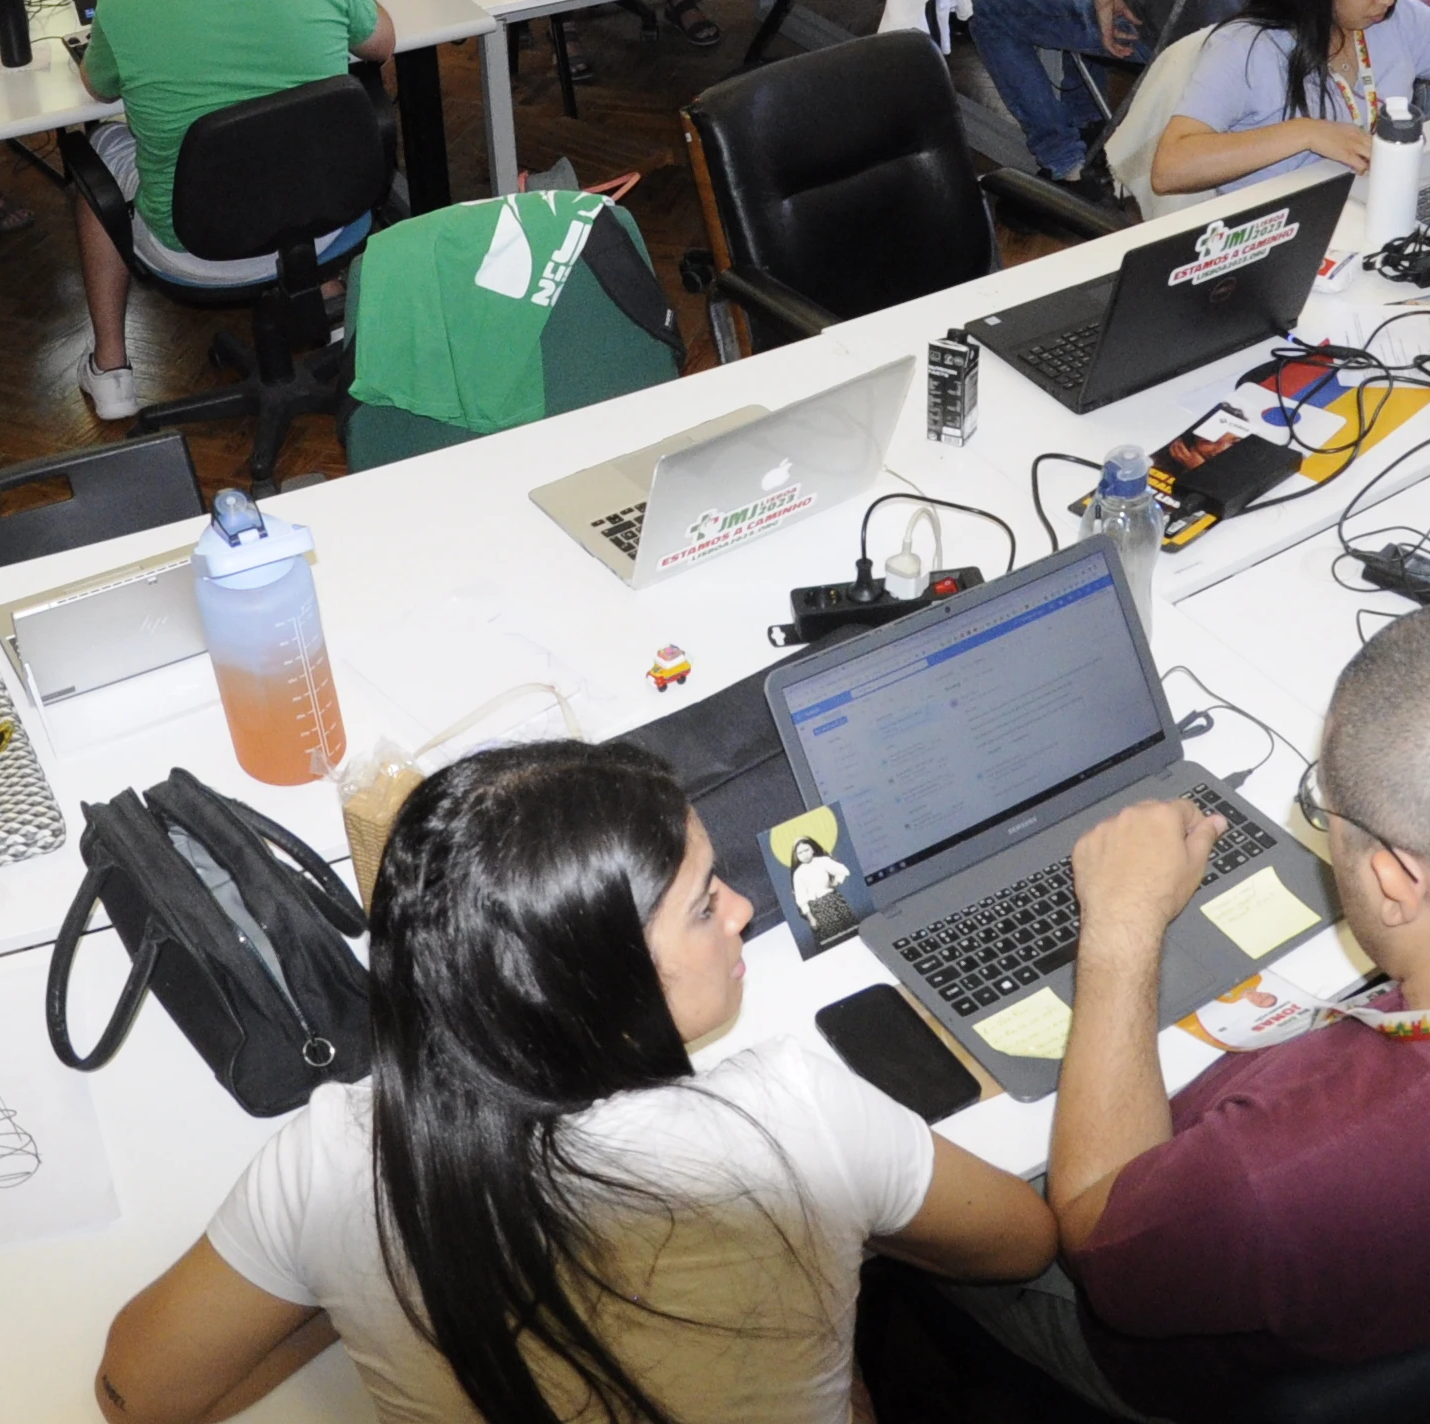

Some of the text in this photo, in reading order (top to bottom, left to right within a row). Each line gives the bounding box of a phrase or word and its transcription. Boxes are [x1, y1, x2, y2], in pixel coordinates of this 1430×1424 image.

[1220, 224, 1256, 252] JMJ
[1253, 220, 1283, 239] 2023
[1173, 227, 1295, 281] ESTAMOS A CAMINHO
[717, 501, 760, 533] JMJ
[758, 493, 795, 517] 2023
[661, 496, 813, 567] ESTAMOS A CAMINHO
